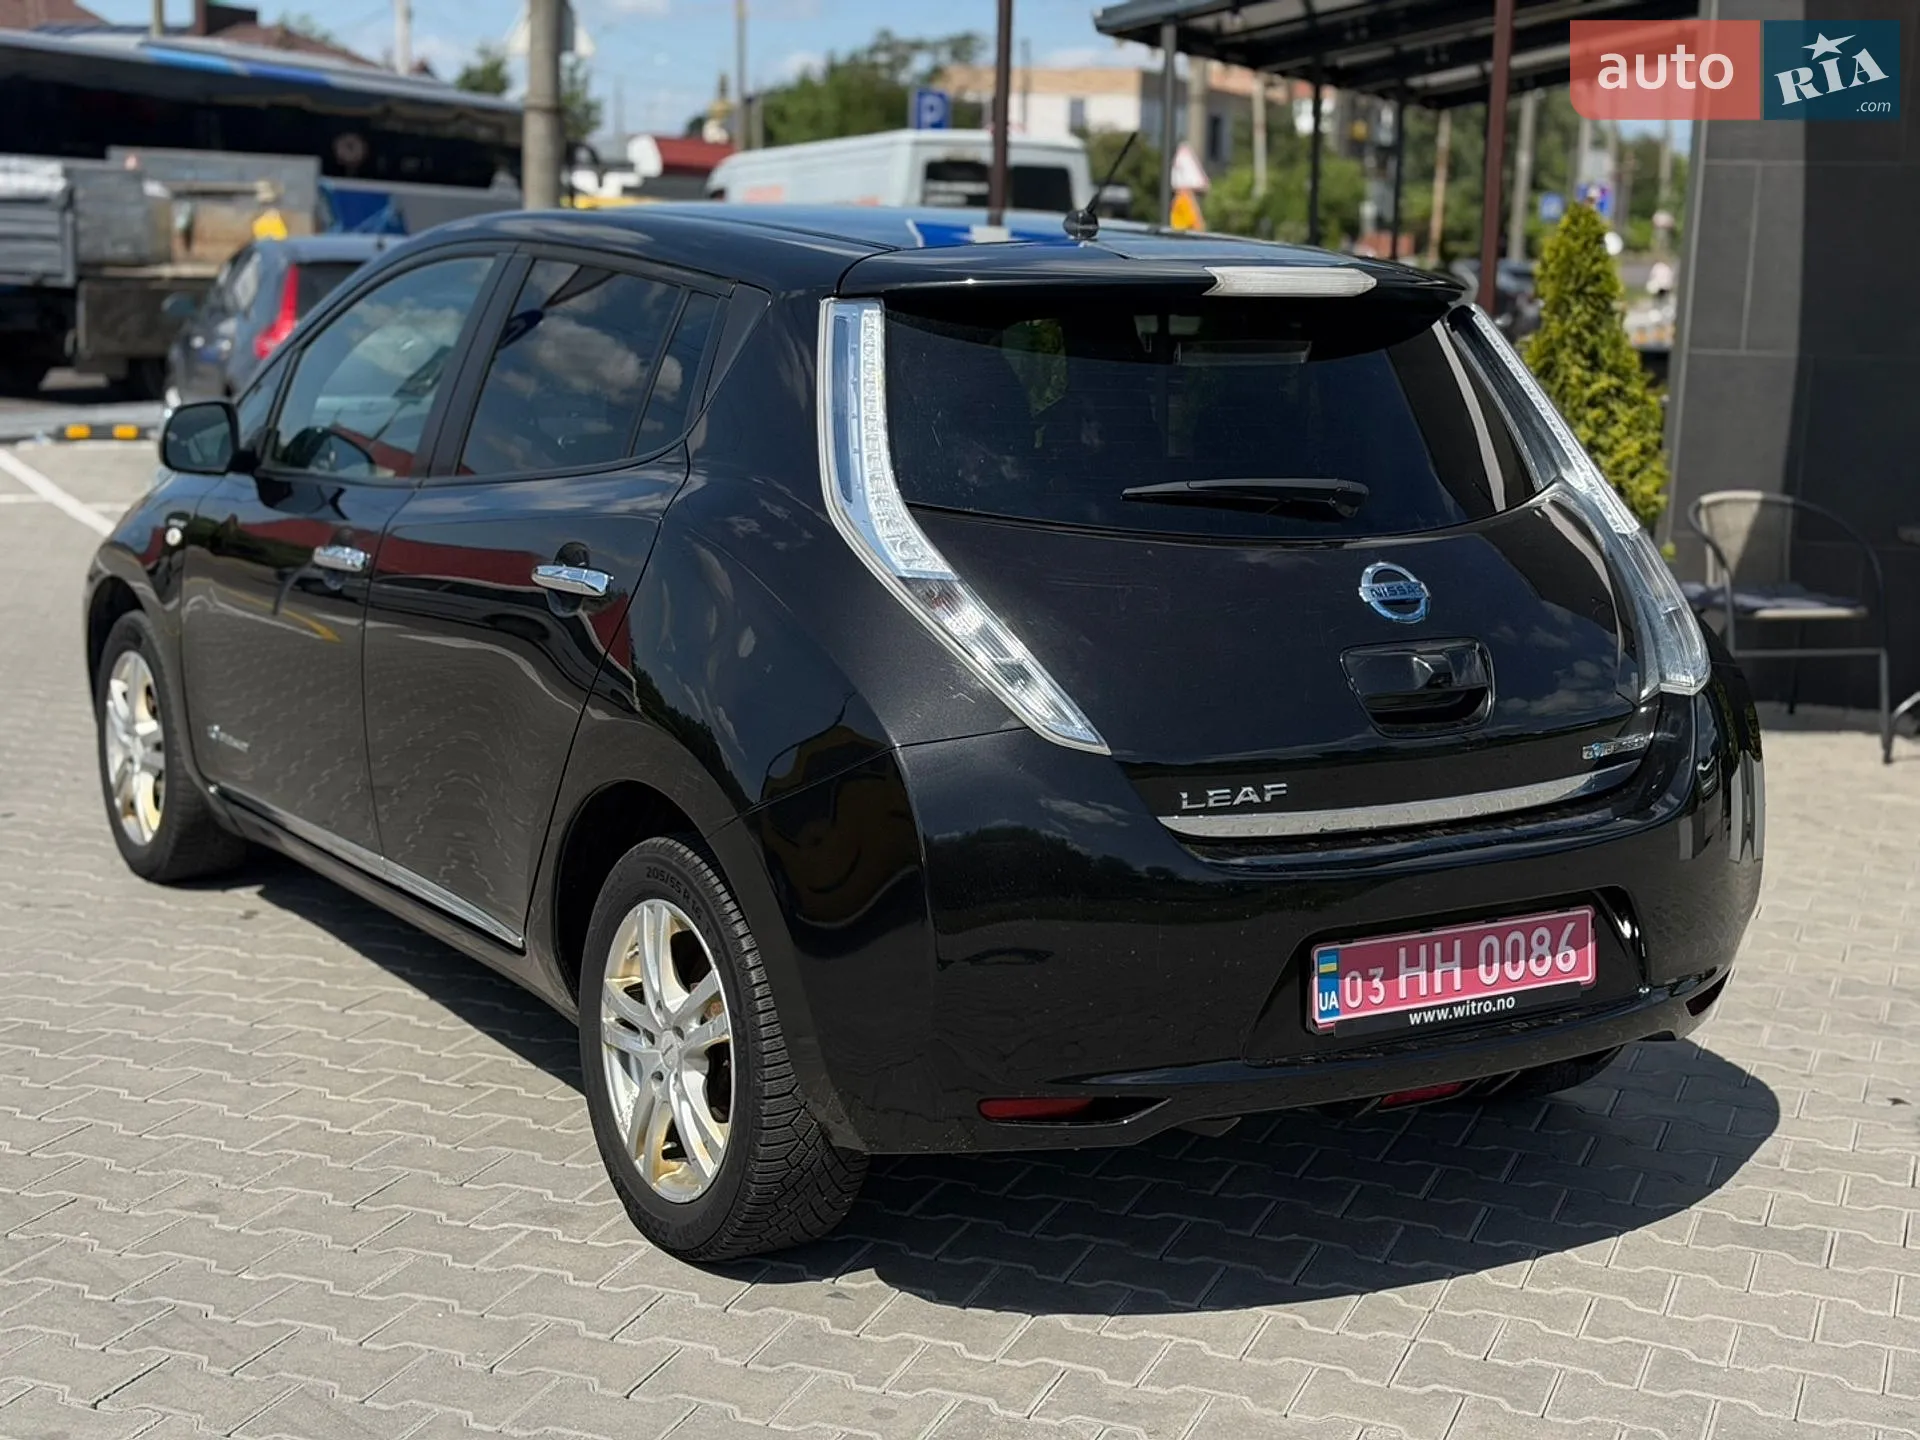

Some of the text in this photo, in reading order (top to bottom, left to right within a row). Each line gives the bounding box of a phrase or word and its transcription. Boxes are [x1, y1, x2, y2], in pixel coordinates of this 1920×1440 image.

[920, 94, 946, 129] P
[1180, 783, 1288, 810] LEAF
[1344, 922, 1577, 1008] 03 HH 0086
[1319, 990, 1339, 1011] UA
[1409, 996, 1516, 1025] www.witro.no
